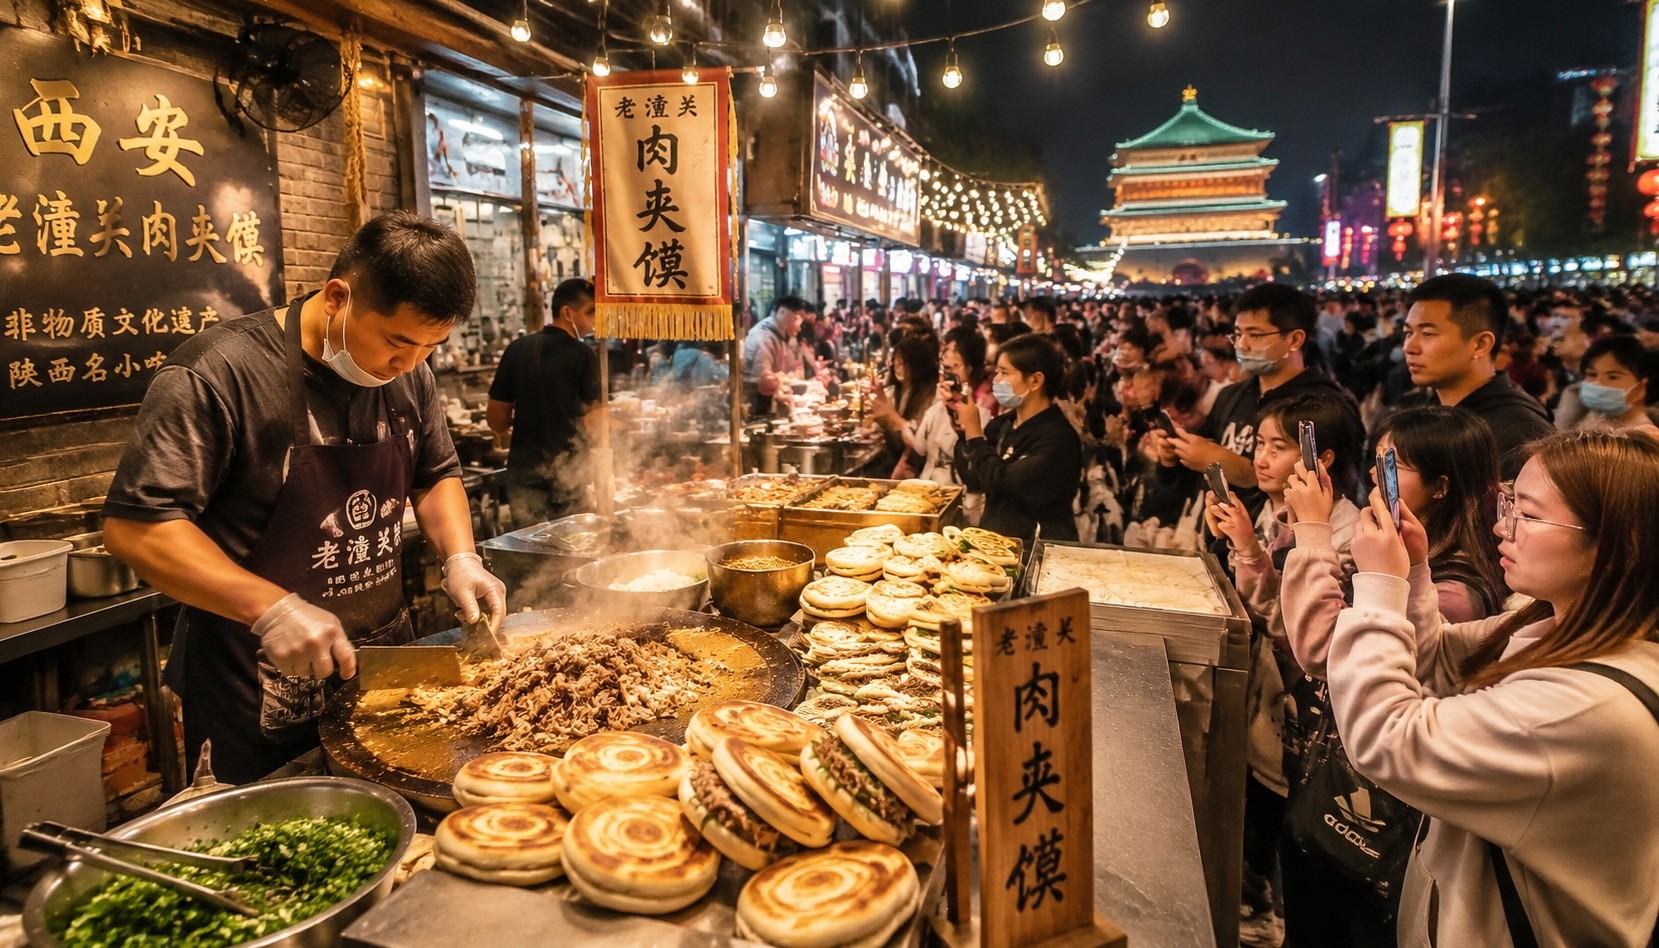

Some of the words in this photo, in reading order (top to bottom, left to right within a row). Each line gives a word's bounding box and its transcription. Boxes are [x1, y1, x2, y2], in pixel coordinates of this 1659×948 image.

[12, 77, 205, 187] 西安
[0, 190, 265, 267] 老潼关肉夹馍
[633, 125, 690, 290] 肉夹馍
[1005, 662, 1067, 912] 肉夹馍
